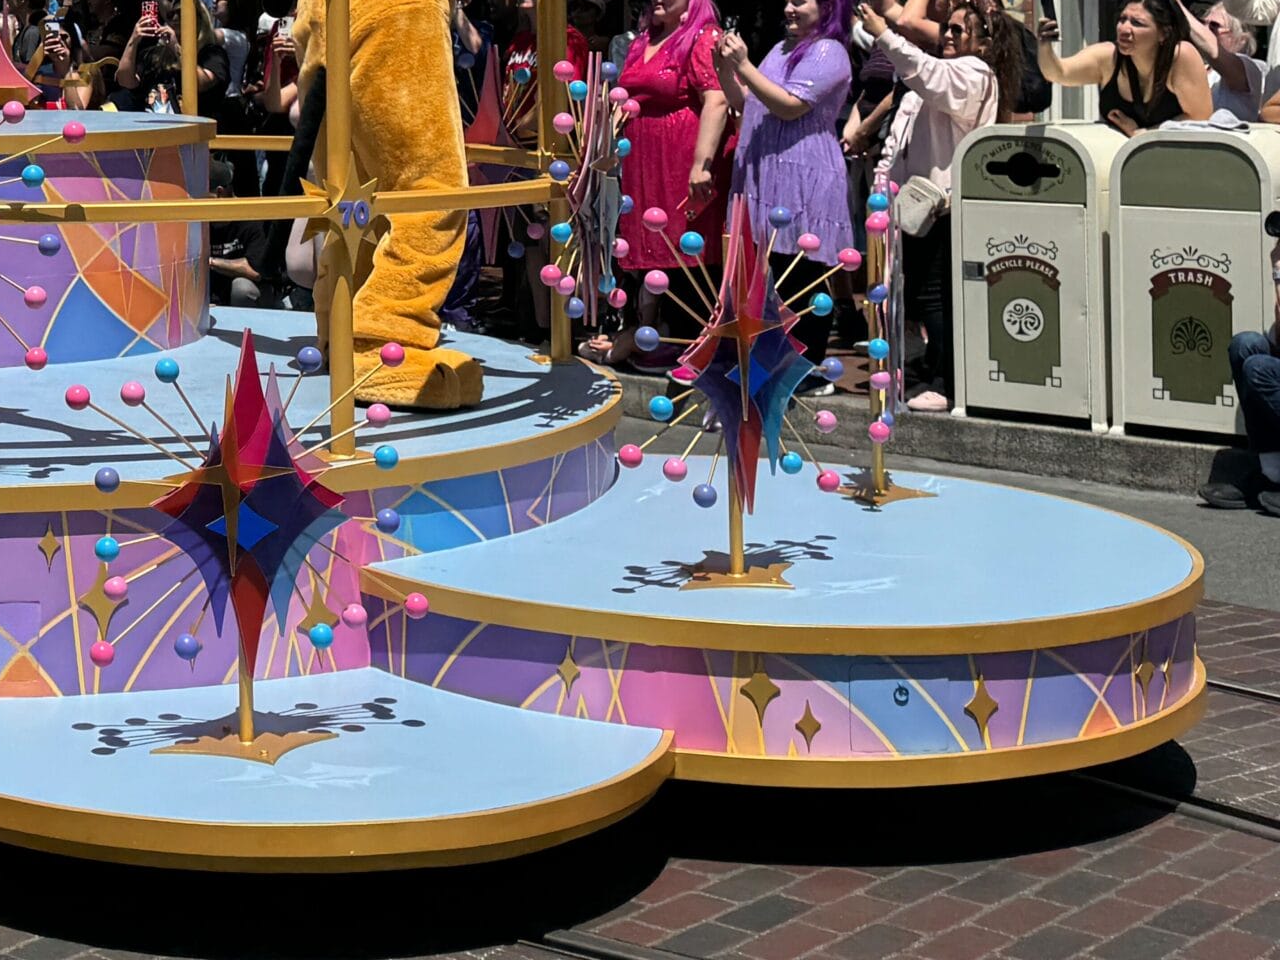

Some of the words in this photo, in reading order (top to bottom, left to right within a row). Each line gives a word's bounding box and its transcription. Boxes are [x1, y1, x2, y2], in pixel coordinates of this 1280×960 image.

[989, 142, 1013, 157] MIXED
[338, 200, 370, 229] 70
[990, 259, 1023, 273] RECYCLE
[1025, 260, 1055, 278] PLEASE
[1167, 271, 1214, 287] TRASH
